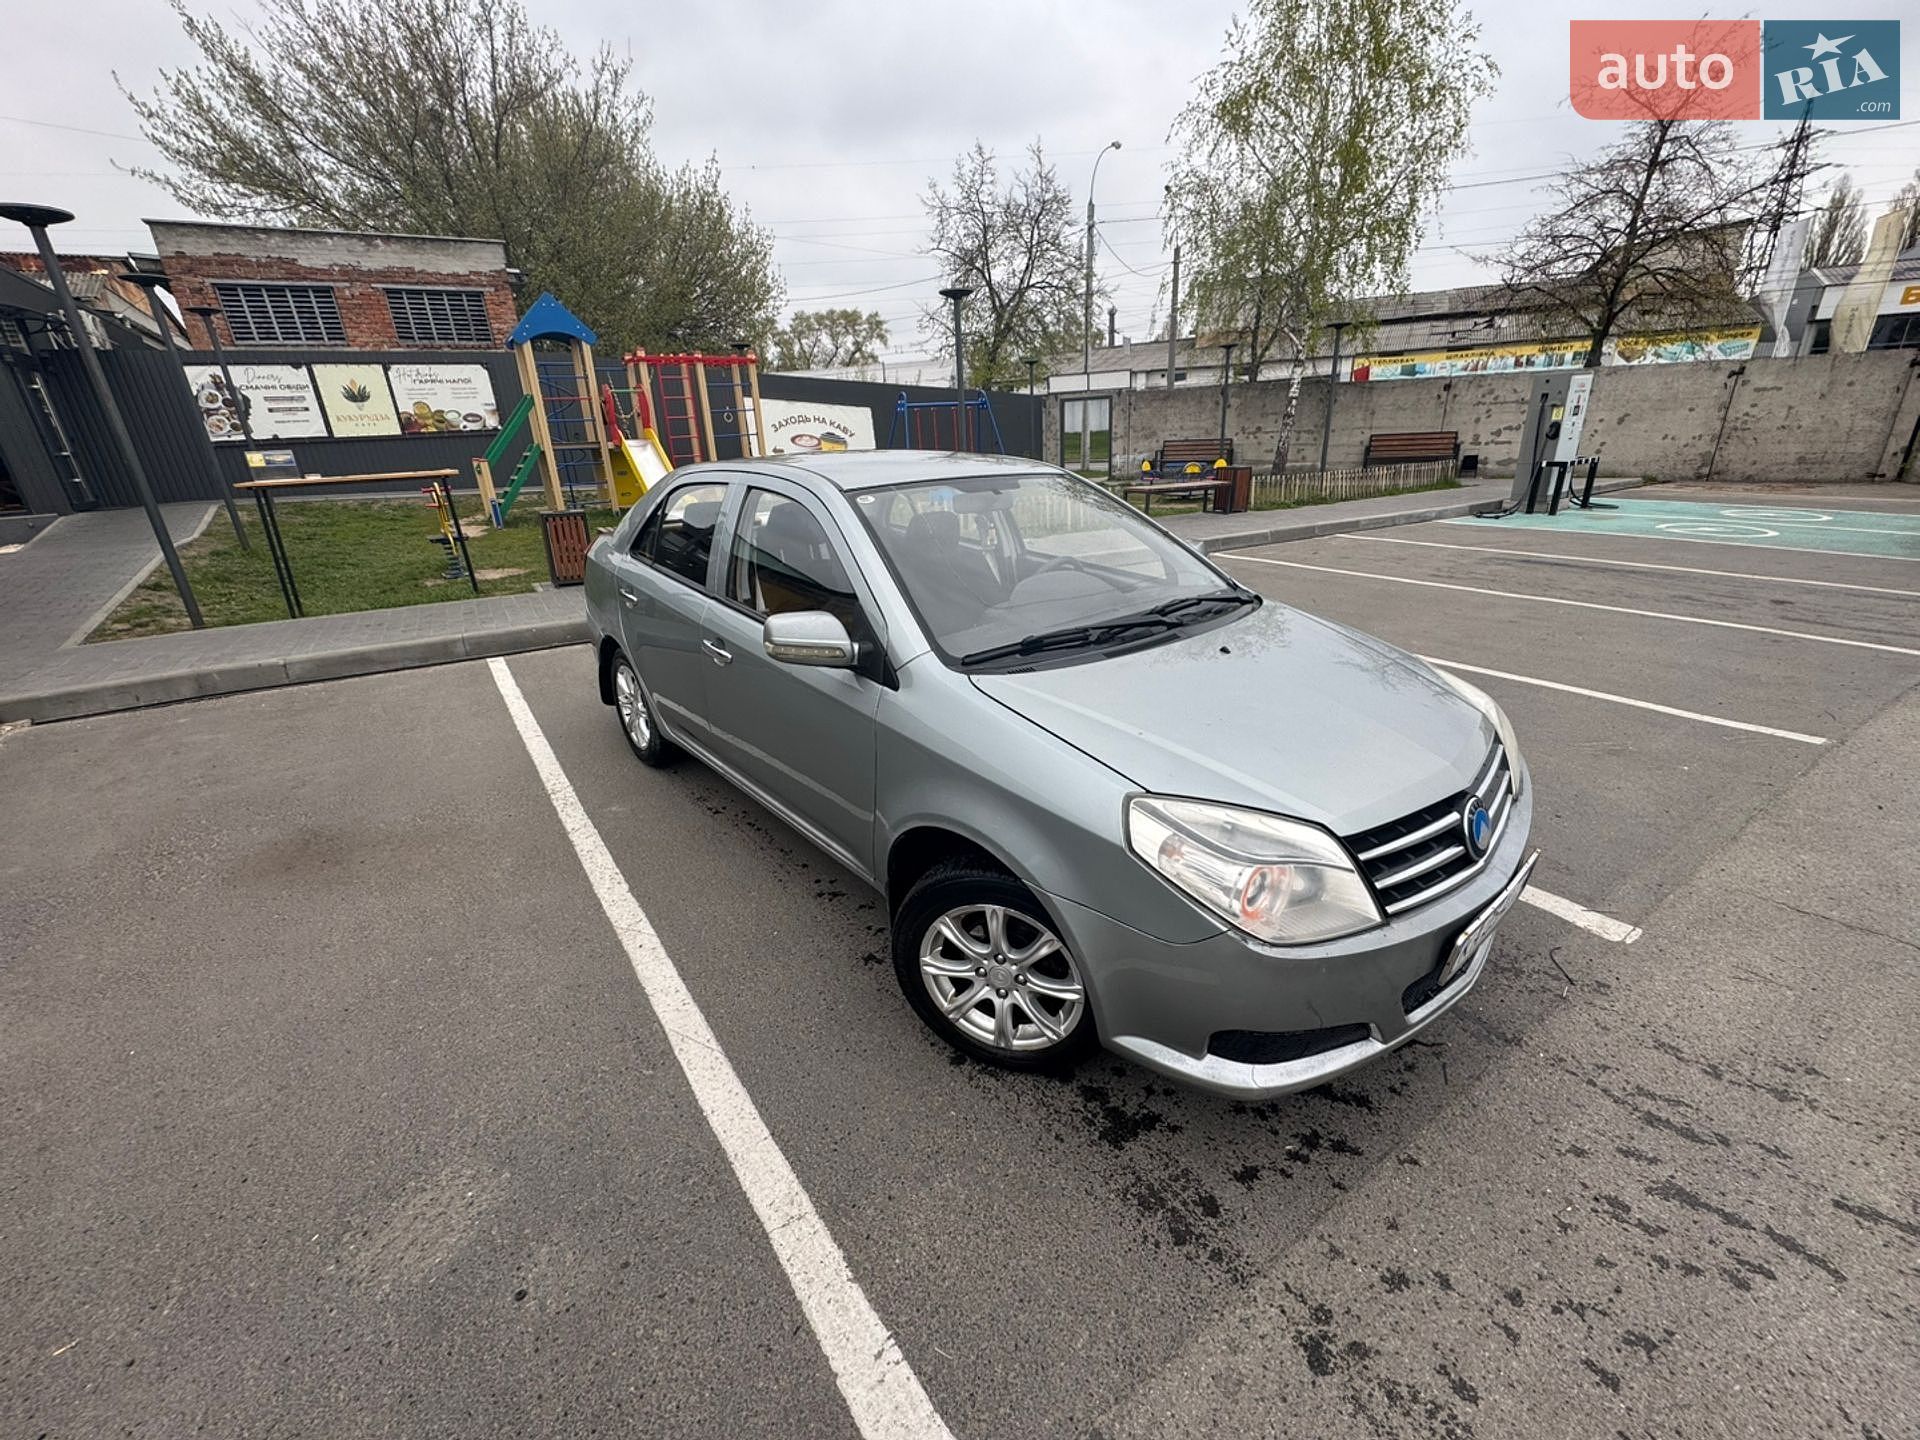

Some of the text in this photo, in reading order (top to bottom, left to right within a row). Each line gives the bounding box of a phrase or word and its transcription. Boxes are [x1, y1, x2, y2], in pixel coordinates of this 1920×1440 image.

[771, 414, 856, 438] ЗАХОДЬ НА КАВУ
